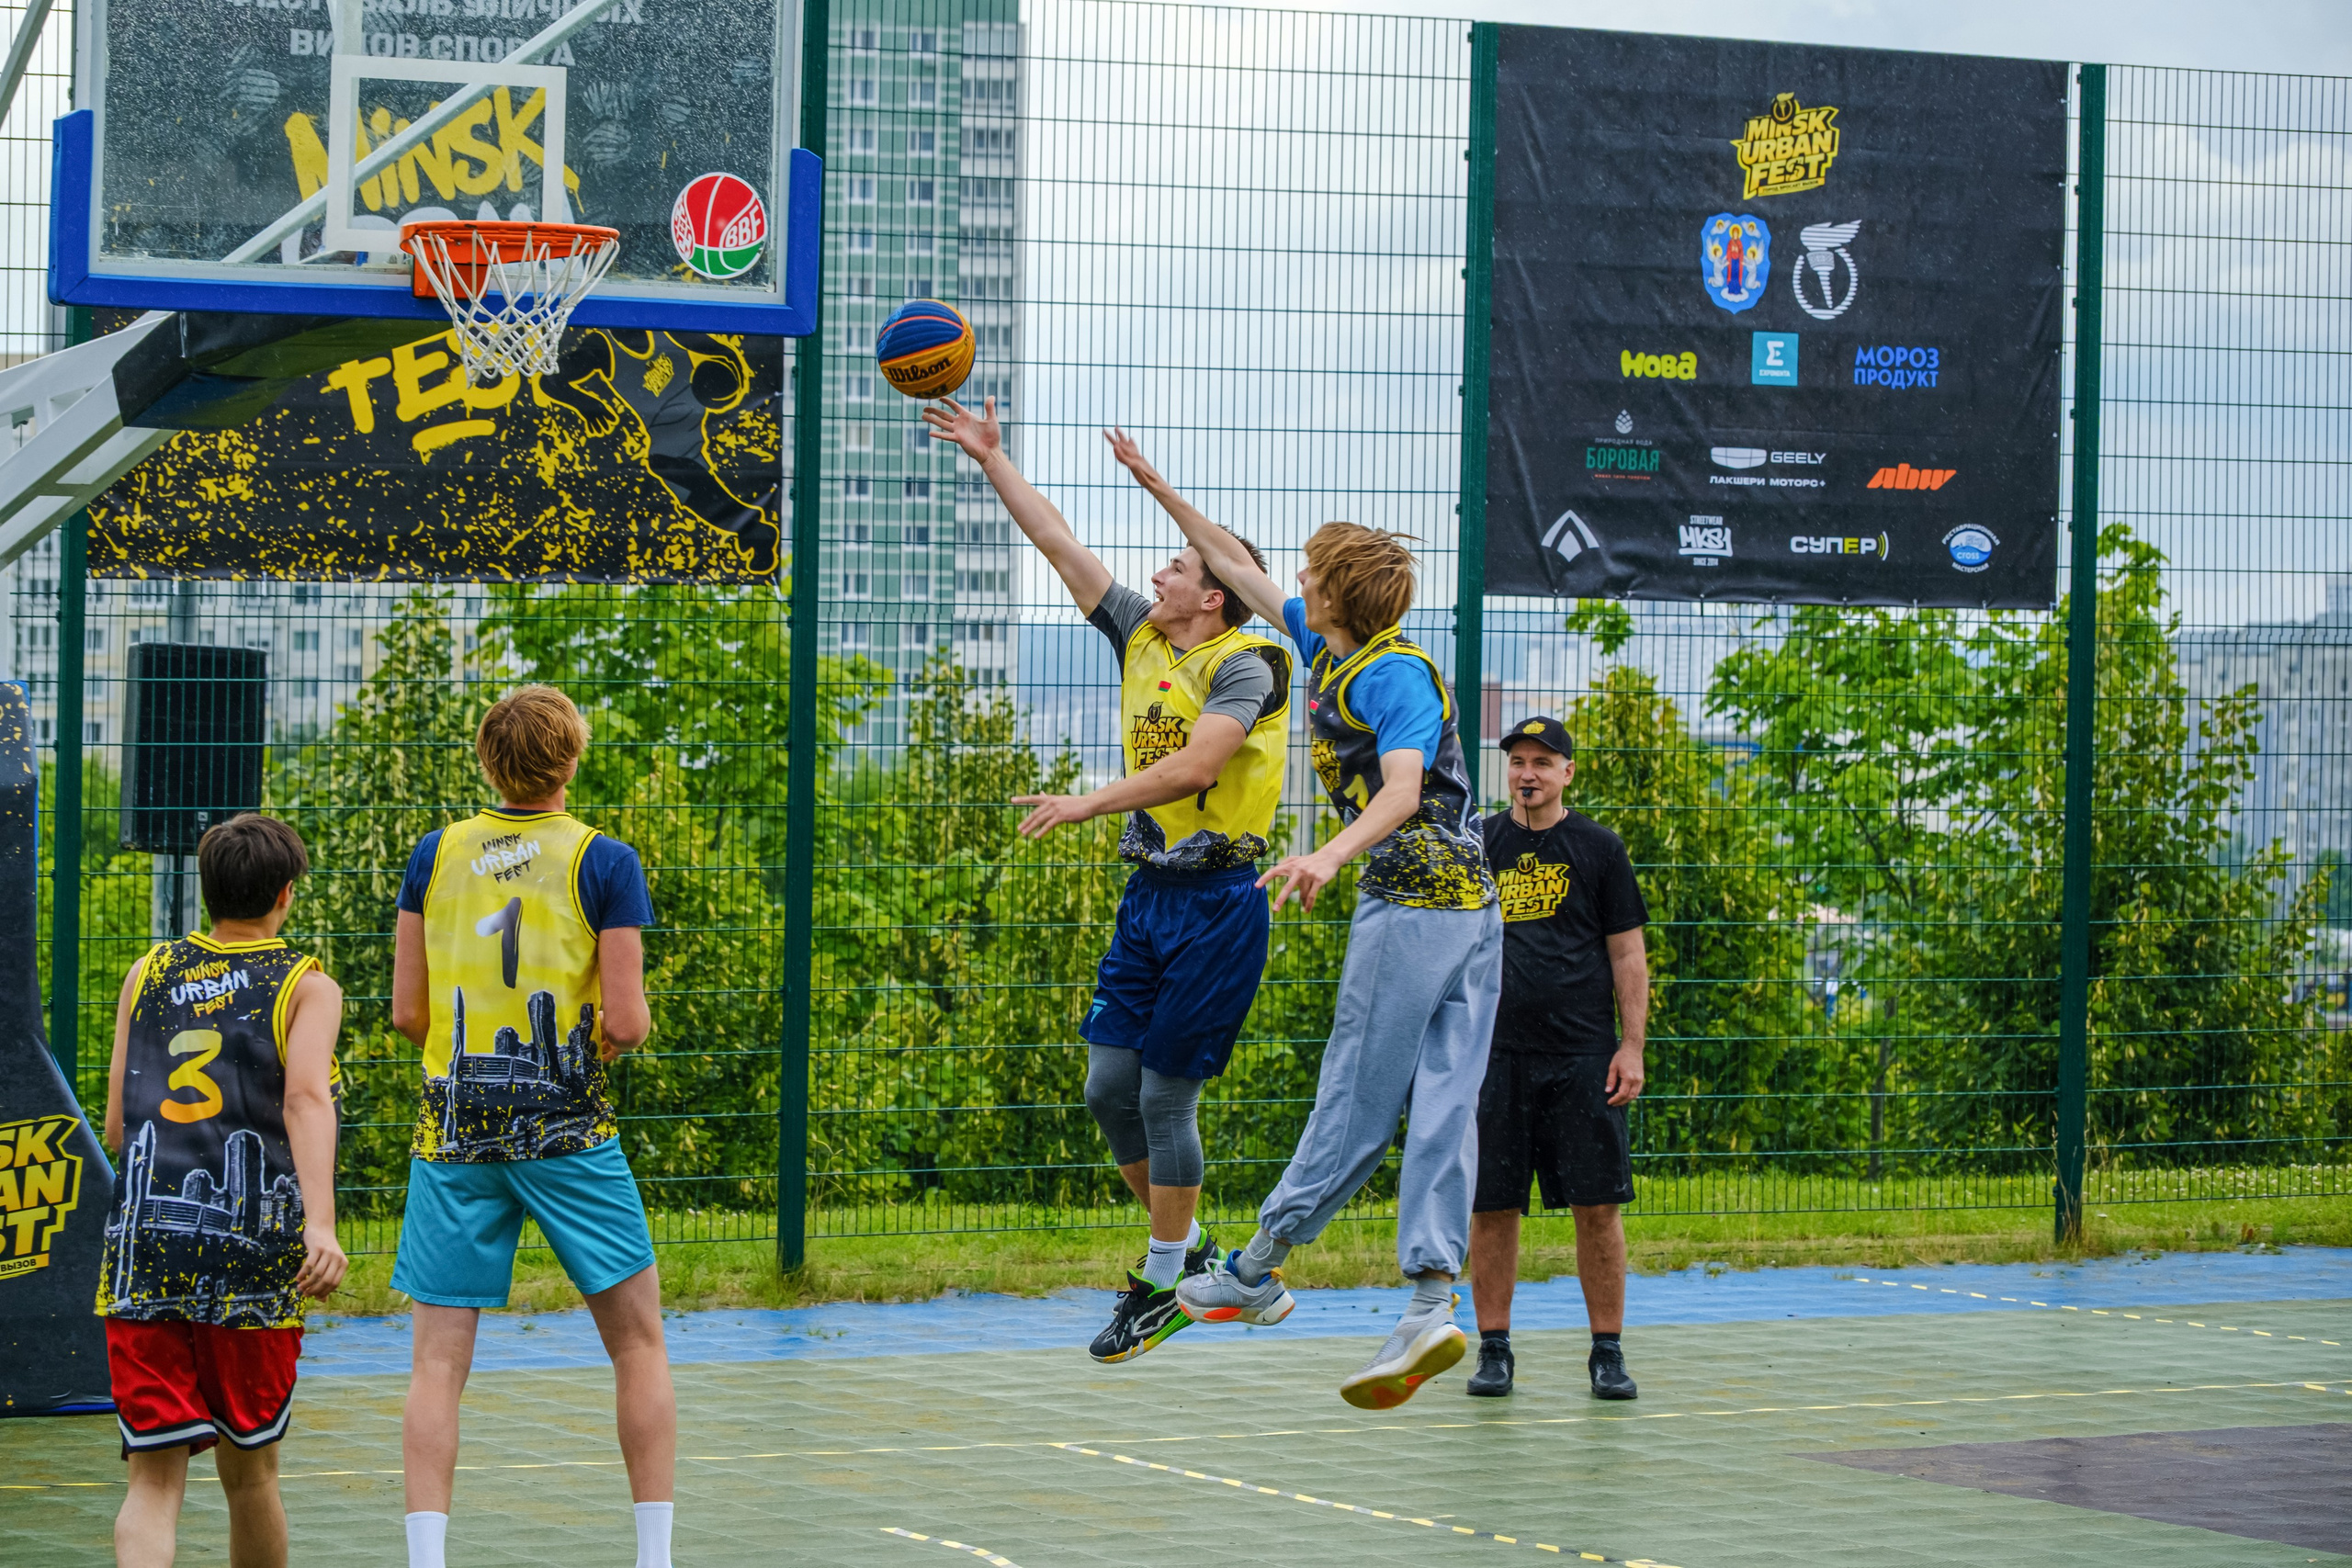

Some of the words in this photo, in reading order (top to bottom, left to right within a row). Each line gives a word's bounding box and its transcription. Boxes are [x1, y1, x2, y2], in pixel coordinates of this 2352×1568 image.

[289, 28, 420, 58] ВИОВ
[1747, 109, 1830, 142] MINSK
[1741, 130, 1833, 164] URBAN
[1748, 153, 1826, 193] FEST
[724, 204, 762, 248] BBF
[1854, 345, 1939, 368] МОРОЗ
[887, 357, 952, 383] Wilson
[1853, 368, 1939, 389] ПРОДУКТ
[1586, 446, 1659, 471] БОРОВАЯ
[1770, 451, 1826, 465] GEELY
[1709, 475, 1766, 486] ЛАКШЕРИ
[1791, 536, 1877, 555] СУПЕР
[1134, 716, 1182, 733] MINSK
[1131, 731, 1185, 749] URBAN
[470, 839, 541, 876] URBAN
[493, 859, 531, 885] FEST
[1498, 866, 1562, 888] MINSK
[1496, 879, 1564, 902] URBAN
[1500, 894, 1556, 919] FEST
[475, 897, 524, 989] 1
[171, 969, 249, 1006] URBAN
[192, 989, 236, 1018] FEST
[160, 1029, 222, 1123] 3
[0, 1258, 37, 1272] ВЫЗОВ
